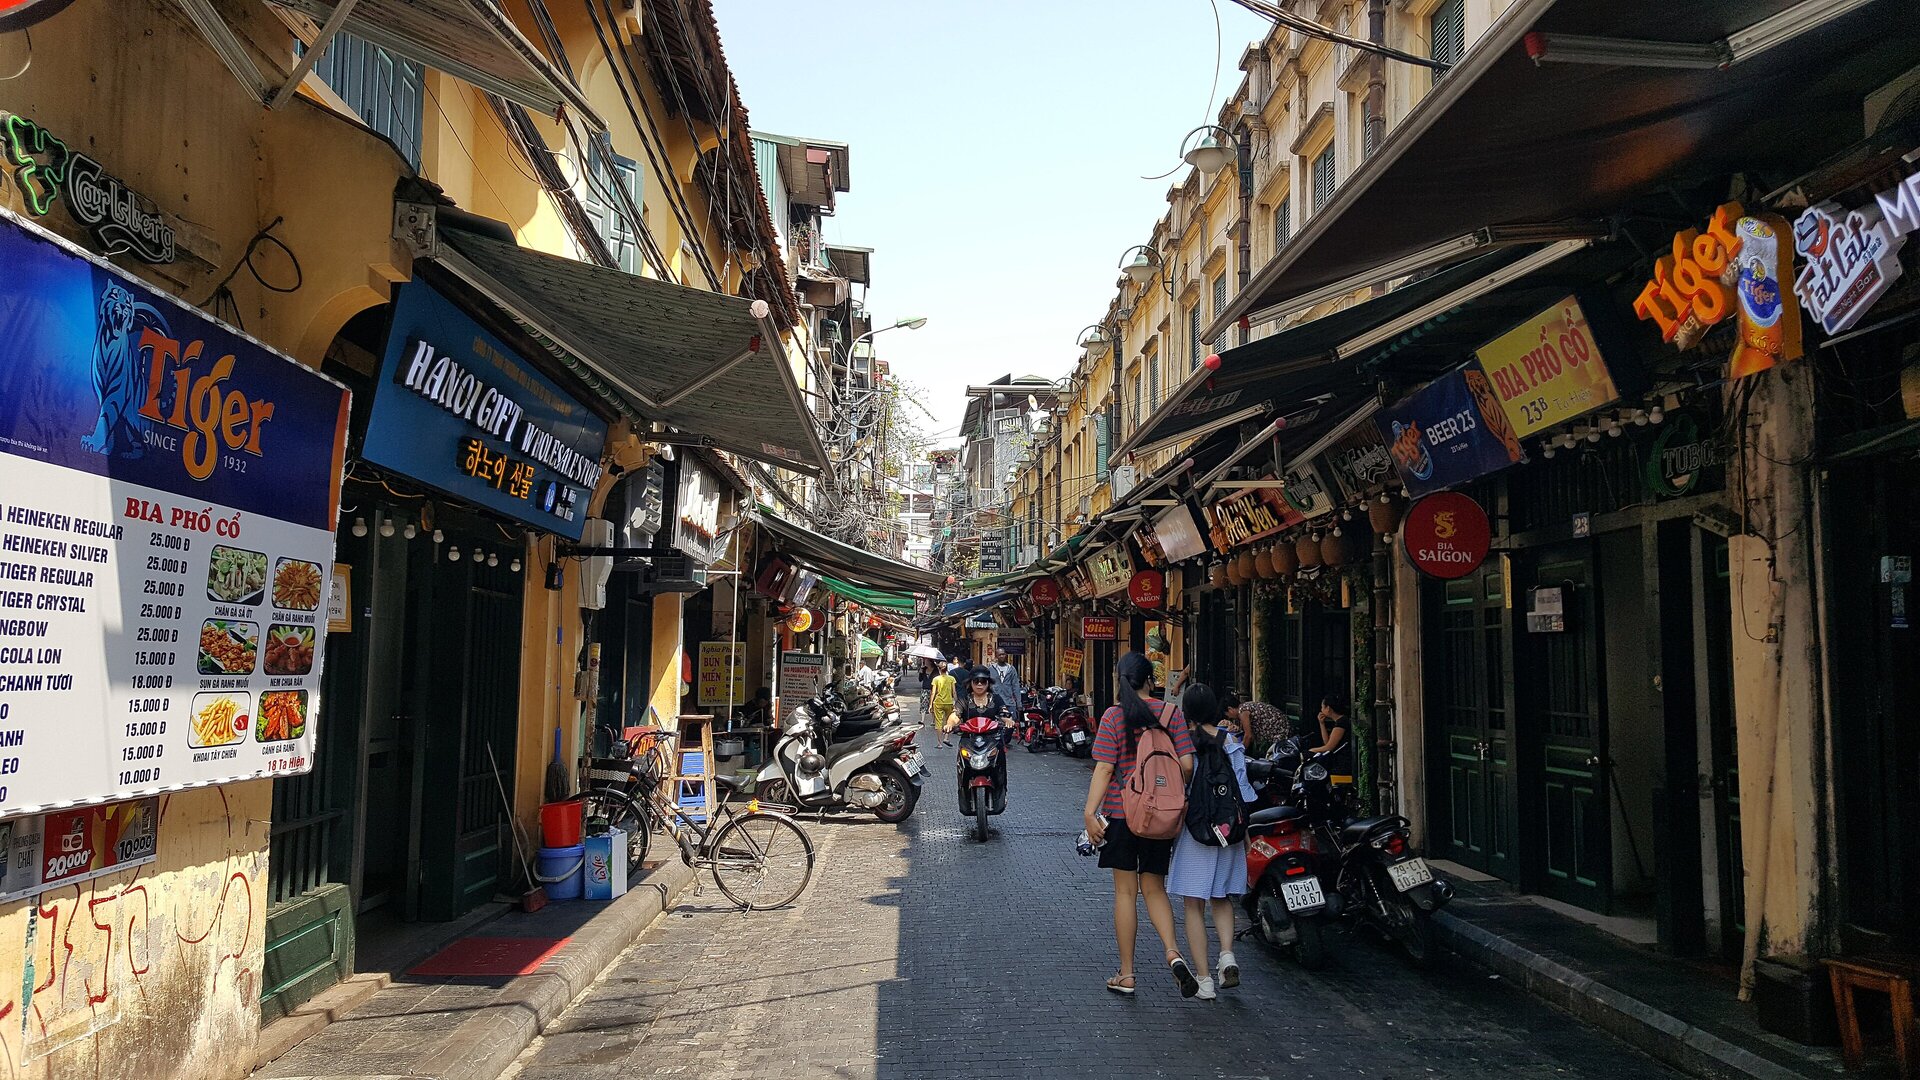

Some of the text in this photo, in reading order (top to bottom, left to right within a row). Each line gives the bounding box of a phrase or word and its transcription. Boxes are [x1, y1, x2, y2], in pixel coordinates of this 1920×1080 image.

[68, 152, 175, 262] Carlsberg
[1633, 204, 1744, 343] Tiger
[1856, 270, 1874, 291] Bar
[1743, 278, 1776, 305] Tiger
[1491, 307, 1590, 402] BIA PHỐ CỔ
[138, 326, 275, 481] Tiger
[405, 340, 483, 420] HANOI
[477, 387, 523, 443] GIFT
[521, 421, 579, 481] WHOLESALE
[575, 454, 603, 491] STORE
[1425, 409, 1476, 446] BEER 23
[143, 429, 177, 452] SINCE
[223, 455, 247, 473] 1932
[1663, 439, 1729, 478] TUBO
[466, 439, 535, 500] 하노이 선물
[7, 505, 71, 532] HEINEKEN
[73, 518, 124, 541] REGULAR
[124, 497, 241, 539] BIA PHỐ CỔ
[2, 533, 108, 564] HEINEKEN SILVER
[149, 532, 191, 551] 25.000 Đ
[1437, 542, 1453, 550] BIA
[146, 555, 188, 574] 25.000 Đ
[1418, 549, 1472, 563] SAIGON
[0, 561, 94, 588] TIGER REGULAR
[143, 579, 185, 597] 25.000 Đ
[36, 593, 86, 613] CRYSTAL
[1136, 595, 1160, 603] SAIGON
[140, 603, 182, 620] 25.000 Đ
[137, 627, 179, 643] 25.000 Đ
[1087, 623, 1114, 633] Olive
[0, 647, 62, 664] COLA LON
[135, 651, 175, 666] 15.000 Đ
[703, 655, 720, 667] BÚN
[800, 656, 822, 664] EXCHANGE
[0, 673, 73, 692] CHANH TƯƠI
[131, 675, 173, 689] 18.000 Đ
[269, 678, 281, 687] NEM
[281, 677, 293, 686] CHUA
[128, 698, 170, 713] 15.000 Đ
[125, 721, 167, 737] 15.000 Đ
[122, 744, 164, 761] 15.000 Đ
[192, 752, 210, 762] KHOAI
[283, 743, 295, 753] RANG
[0, 757, 19, 775] EO
[267, 760, 277, 772] 18
[119, 767, 160, 786] 10.000 Đ
[1393, 860, 1422, 878] 29-C1
[1288, 881, 1315, 896] 19-G1
[1288, 891, 1322, 909] 348.67
